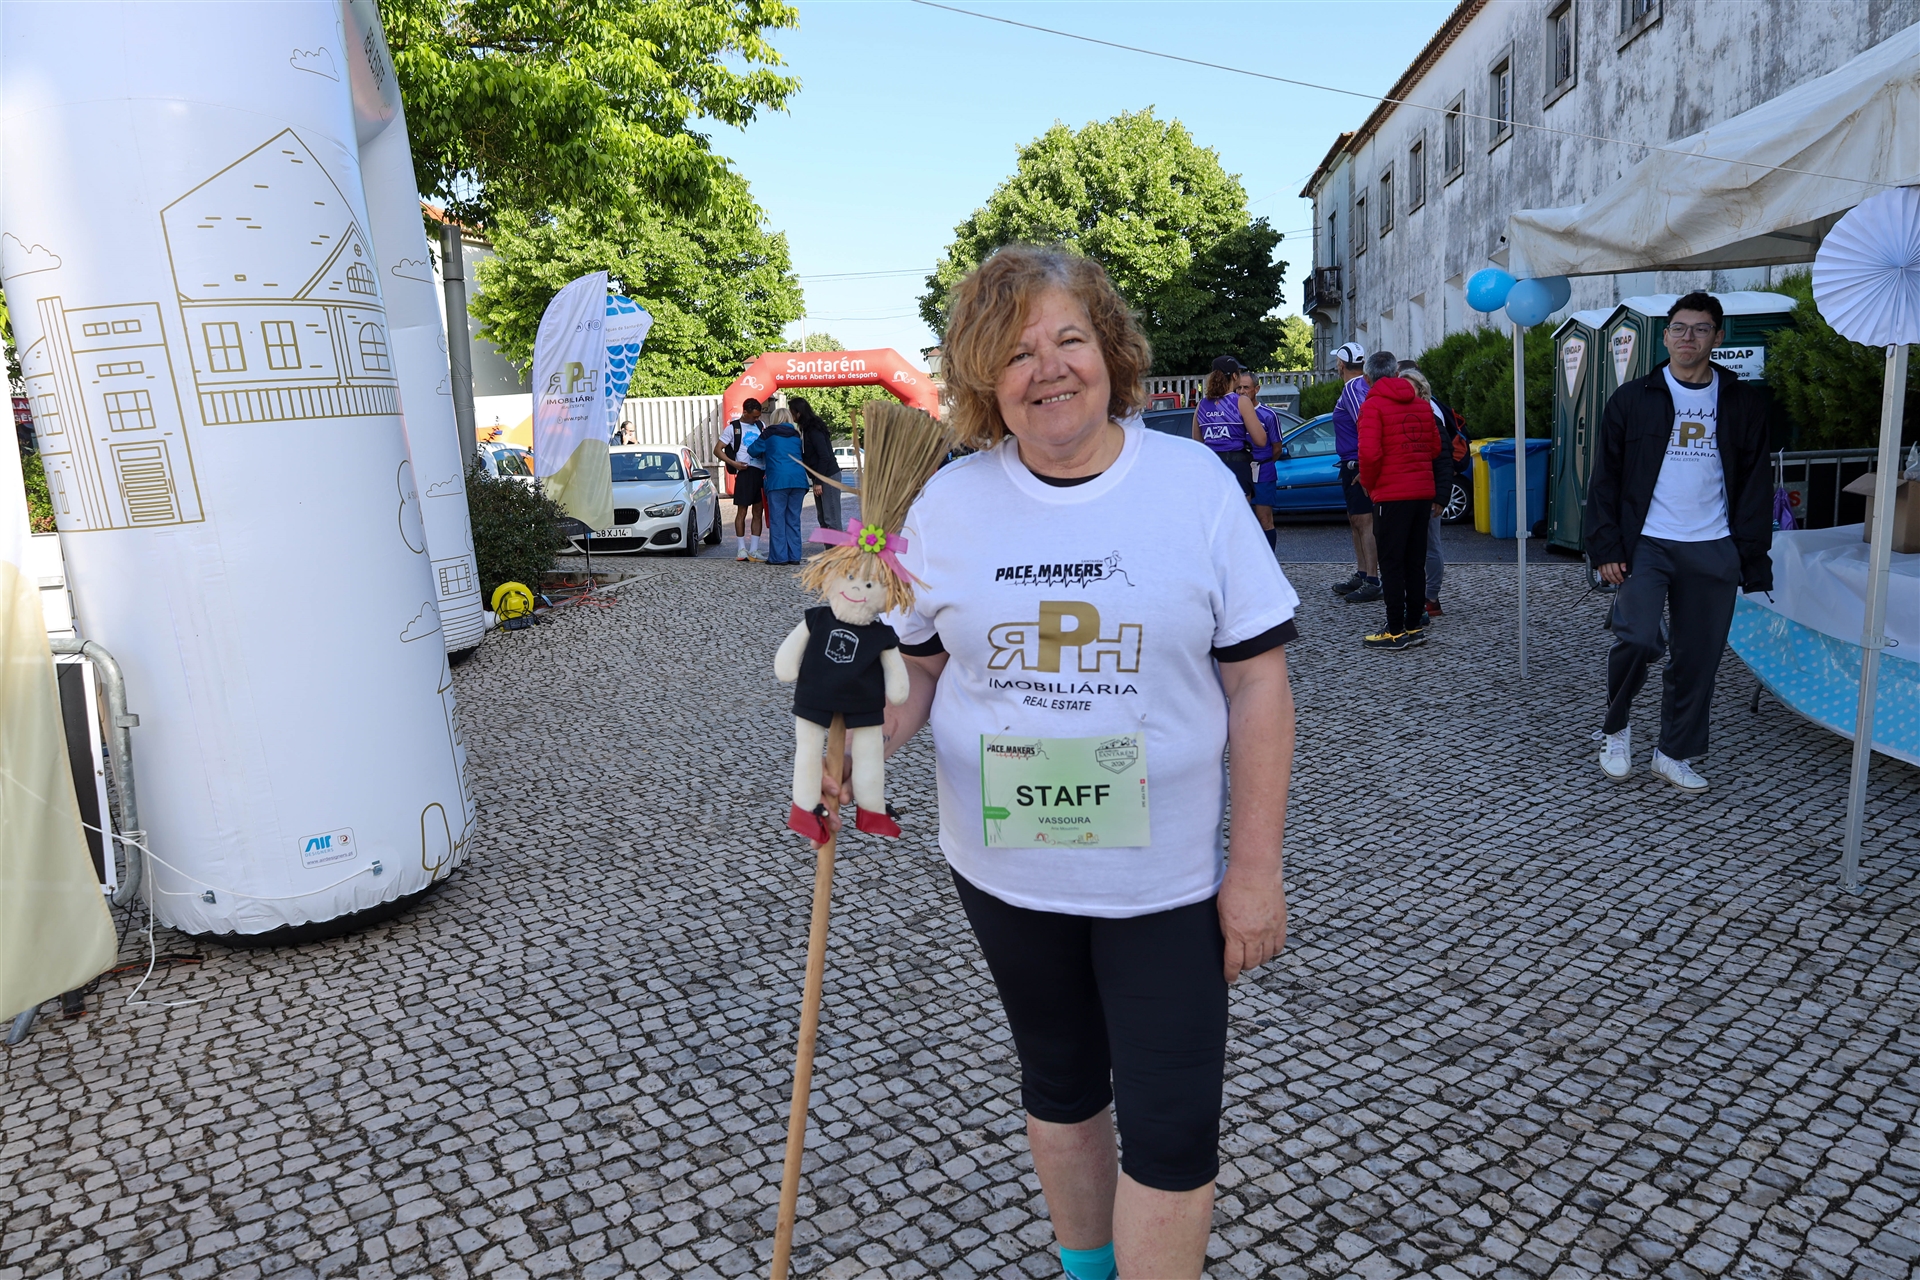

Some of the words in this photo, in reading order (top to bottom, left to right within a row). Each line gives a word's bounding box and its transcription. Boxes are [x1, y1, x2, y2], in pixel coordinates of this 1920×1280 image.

[1711, 350, 1754, 360] ENDAP
[786, 356, 866, 373] Santarém
[1665, 450, 1717, 459] OBILIÁRIA
[988, 677, 1138, 695] IMOBILIÁRIA
[1023, 695, 1048, 708] REAL
[1051, 699, 1092, 711] ESTATE
[1016, 784, 1110, 807] STAFF
[1038, 816, 1091, 824] VASSOURA
